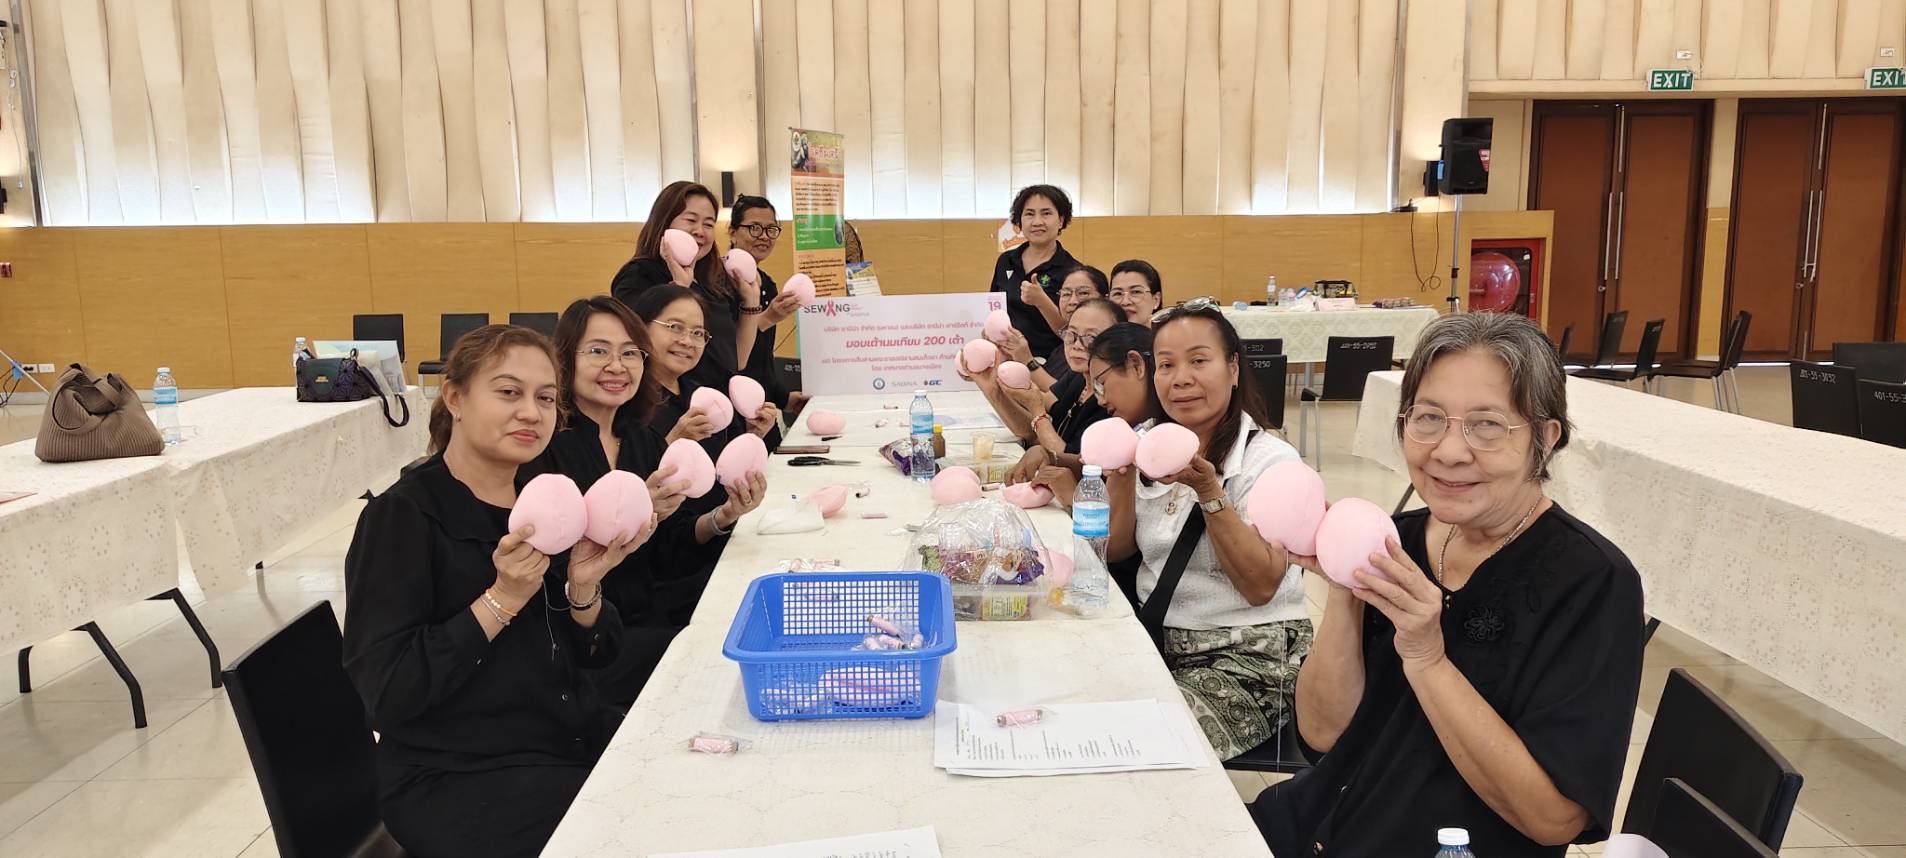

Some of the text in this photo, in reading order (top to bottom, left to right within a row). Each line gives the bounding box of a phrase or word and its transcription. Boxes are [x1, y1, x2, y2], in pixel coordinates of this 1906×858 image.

[1653, 73, 1691, 88] EXIT
[988, 301, 1002, 311] 19
[846, 334, 965, 348] มอบเต้านมเทียม 200 เต้า
